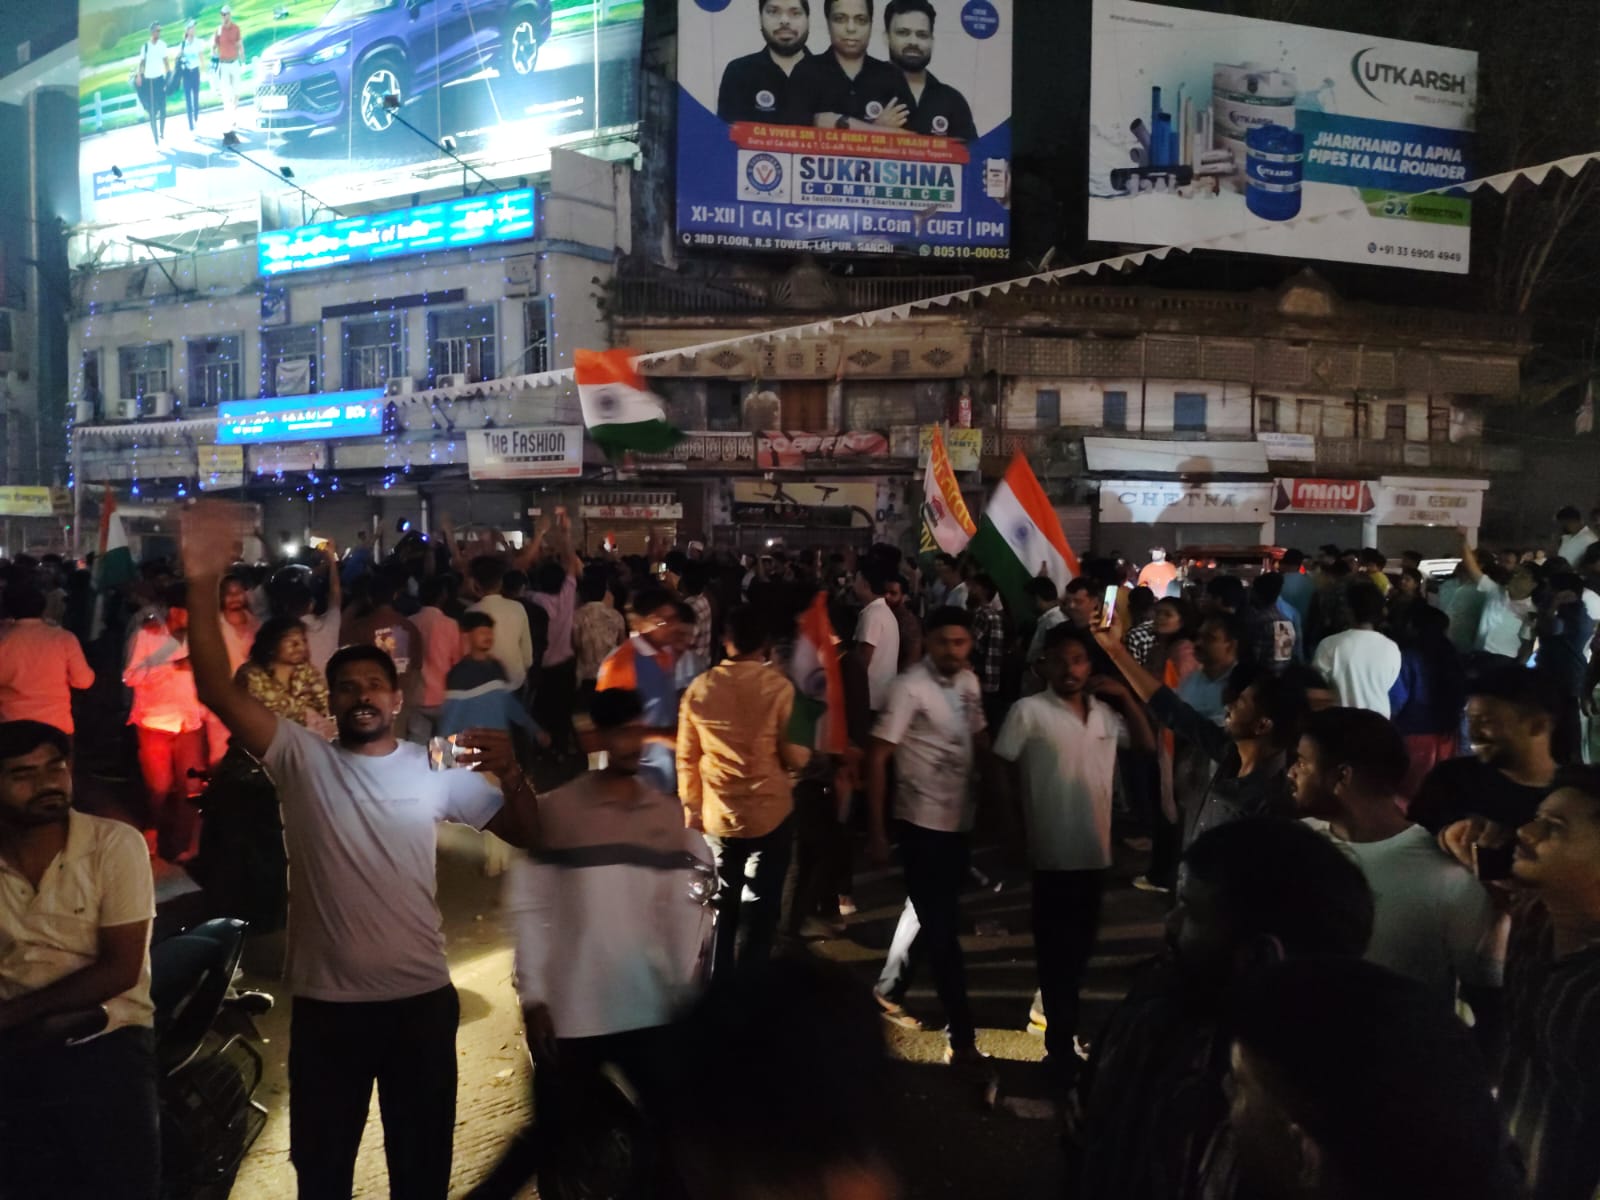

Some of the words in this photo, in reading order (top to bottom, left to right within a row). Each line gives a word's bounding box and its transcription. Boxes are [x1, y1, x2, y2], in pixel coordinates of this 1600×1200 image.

[1364, 61, 1466, 95] UTKARSH
[1312, 131, 1401, 156] JHARKHAND
[1402, 143, 1423, 158] KA
[1424, 145, 1462, 163] APNA
[799, 156, 955, 188] SUKRISHNA
[1307, 148, 1348, 167] PIPES
[1350, 153, 1370, 169] KA
[1371, 155, 1397, 173] ALL
[1399, 159, 1466, 180] ROUNDER
[804, 182, 948, 200] COMMERCE
[690, 205, 736, 224] XI-XII
[752, 210, 773, 227] CA
[784, 212, 804, 228] CS
[816, 213, 850, 231] CMA
[927, 219, 965, 237] CUET
[975, 221, 1005, 238] IPM
[693, 233, 715, 244] 3RD
[1379, 244, 1395, 256] +91
[1397, 246, 1408, 257] 33
[1117, 491, 1238, 507] CHETNA
